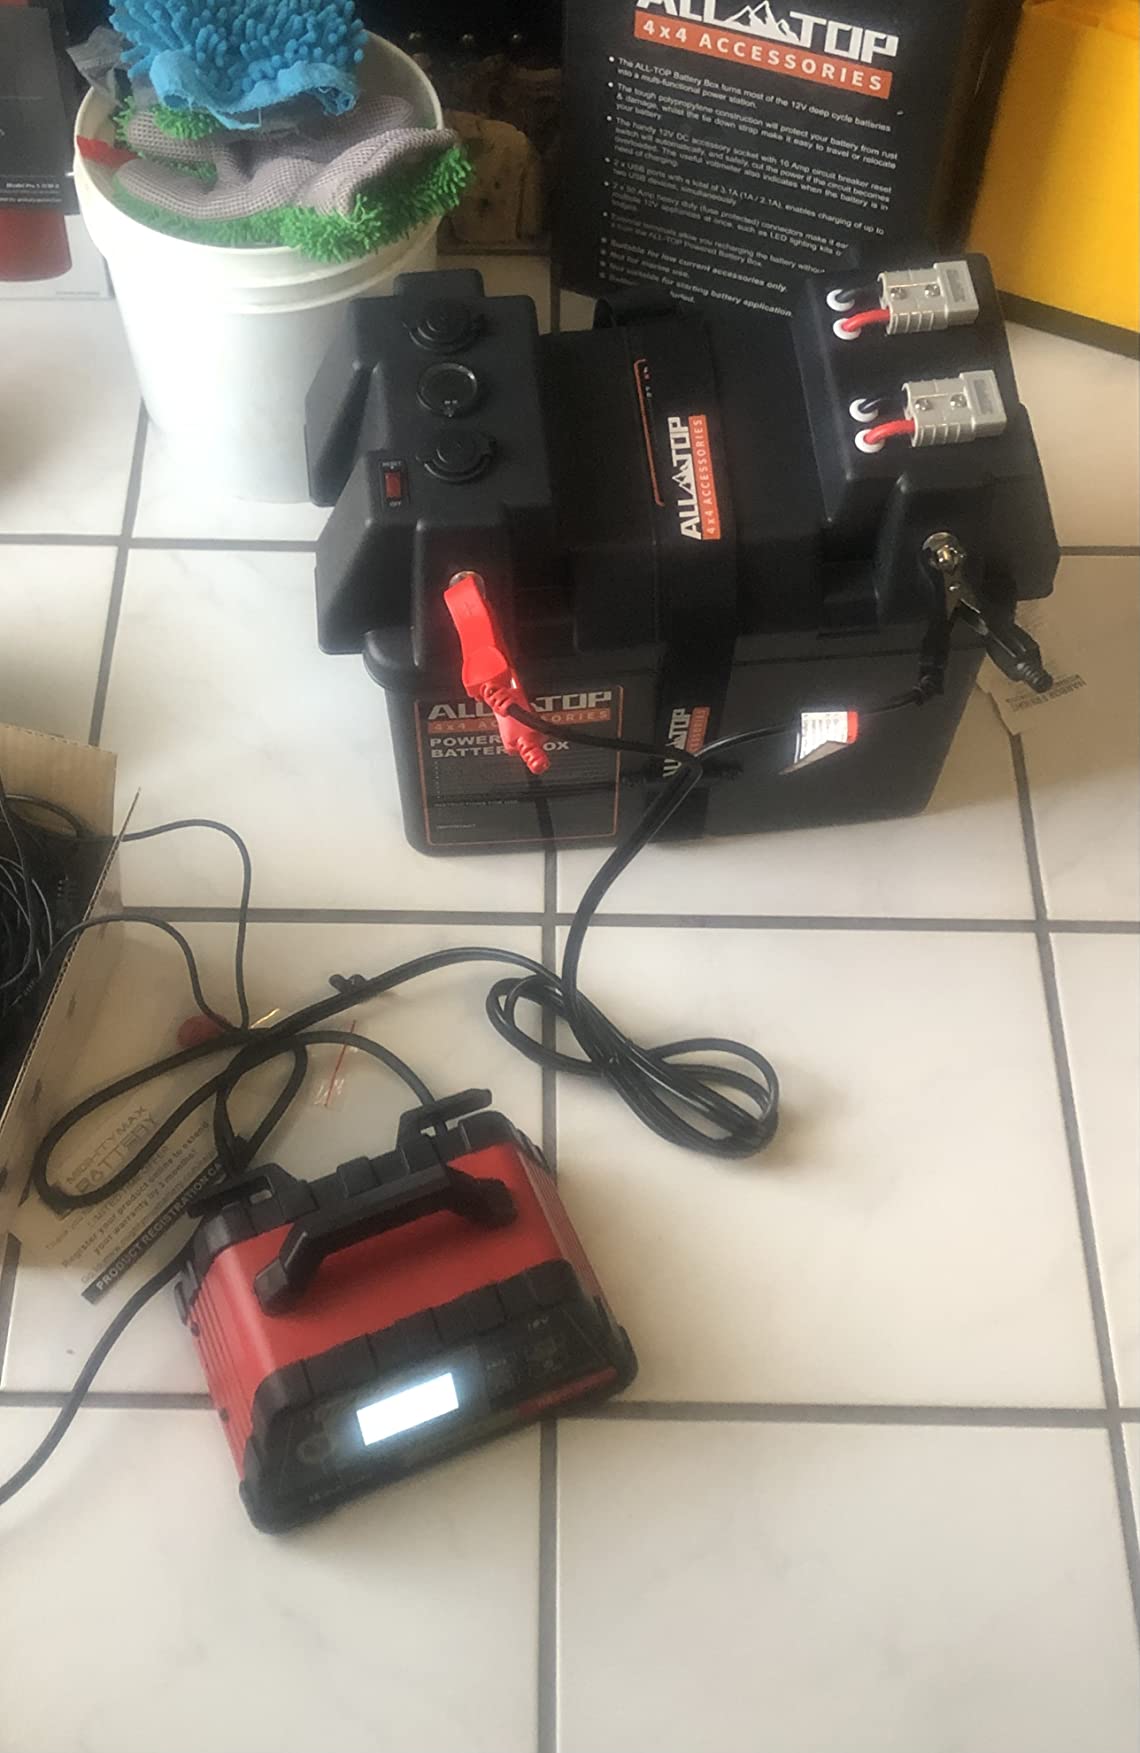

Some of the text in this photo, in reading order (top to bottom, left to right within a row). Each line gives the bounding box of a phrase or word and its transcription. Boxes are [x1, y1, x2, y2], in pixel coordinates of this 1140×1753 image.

[643, 20, 882, 91] 4x4 ACCESSORIES
[618, 58, 632, 67] The
[672, 71, 700, 85] Battery
[703, 78, 718, 88] Box
[721, 83, 740, 94] turns
[742, 88, 763, 99] most
[764, 93, 774, 102] of
[774, 96, 788, 105] the
[792, 100, 806, 110] 12V
[808, 104, 829, 117] deep
[831, 110, 852, 123] cycle
[854, 116, 890, 131] batteries
[710, 289, 741, 305] battery
[692, 419, 716, 535] 4x4 ACCESSORIES
[431, 746, 507, 758] BATTER
[96, 1243, 142, 1290] PRODUCT
[141, 1175, 209, 1244] REGISTRATION
[117, 1182, 148, 1215] product
